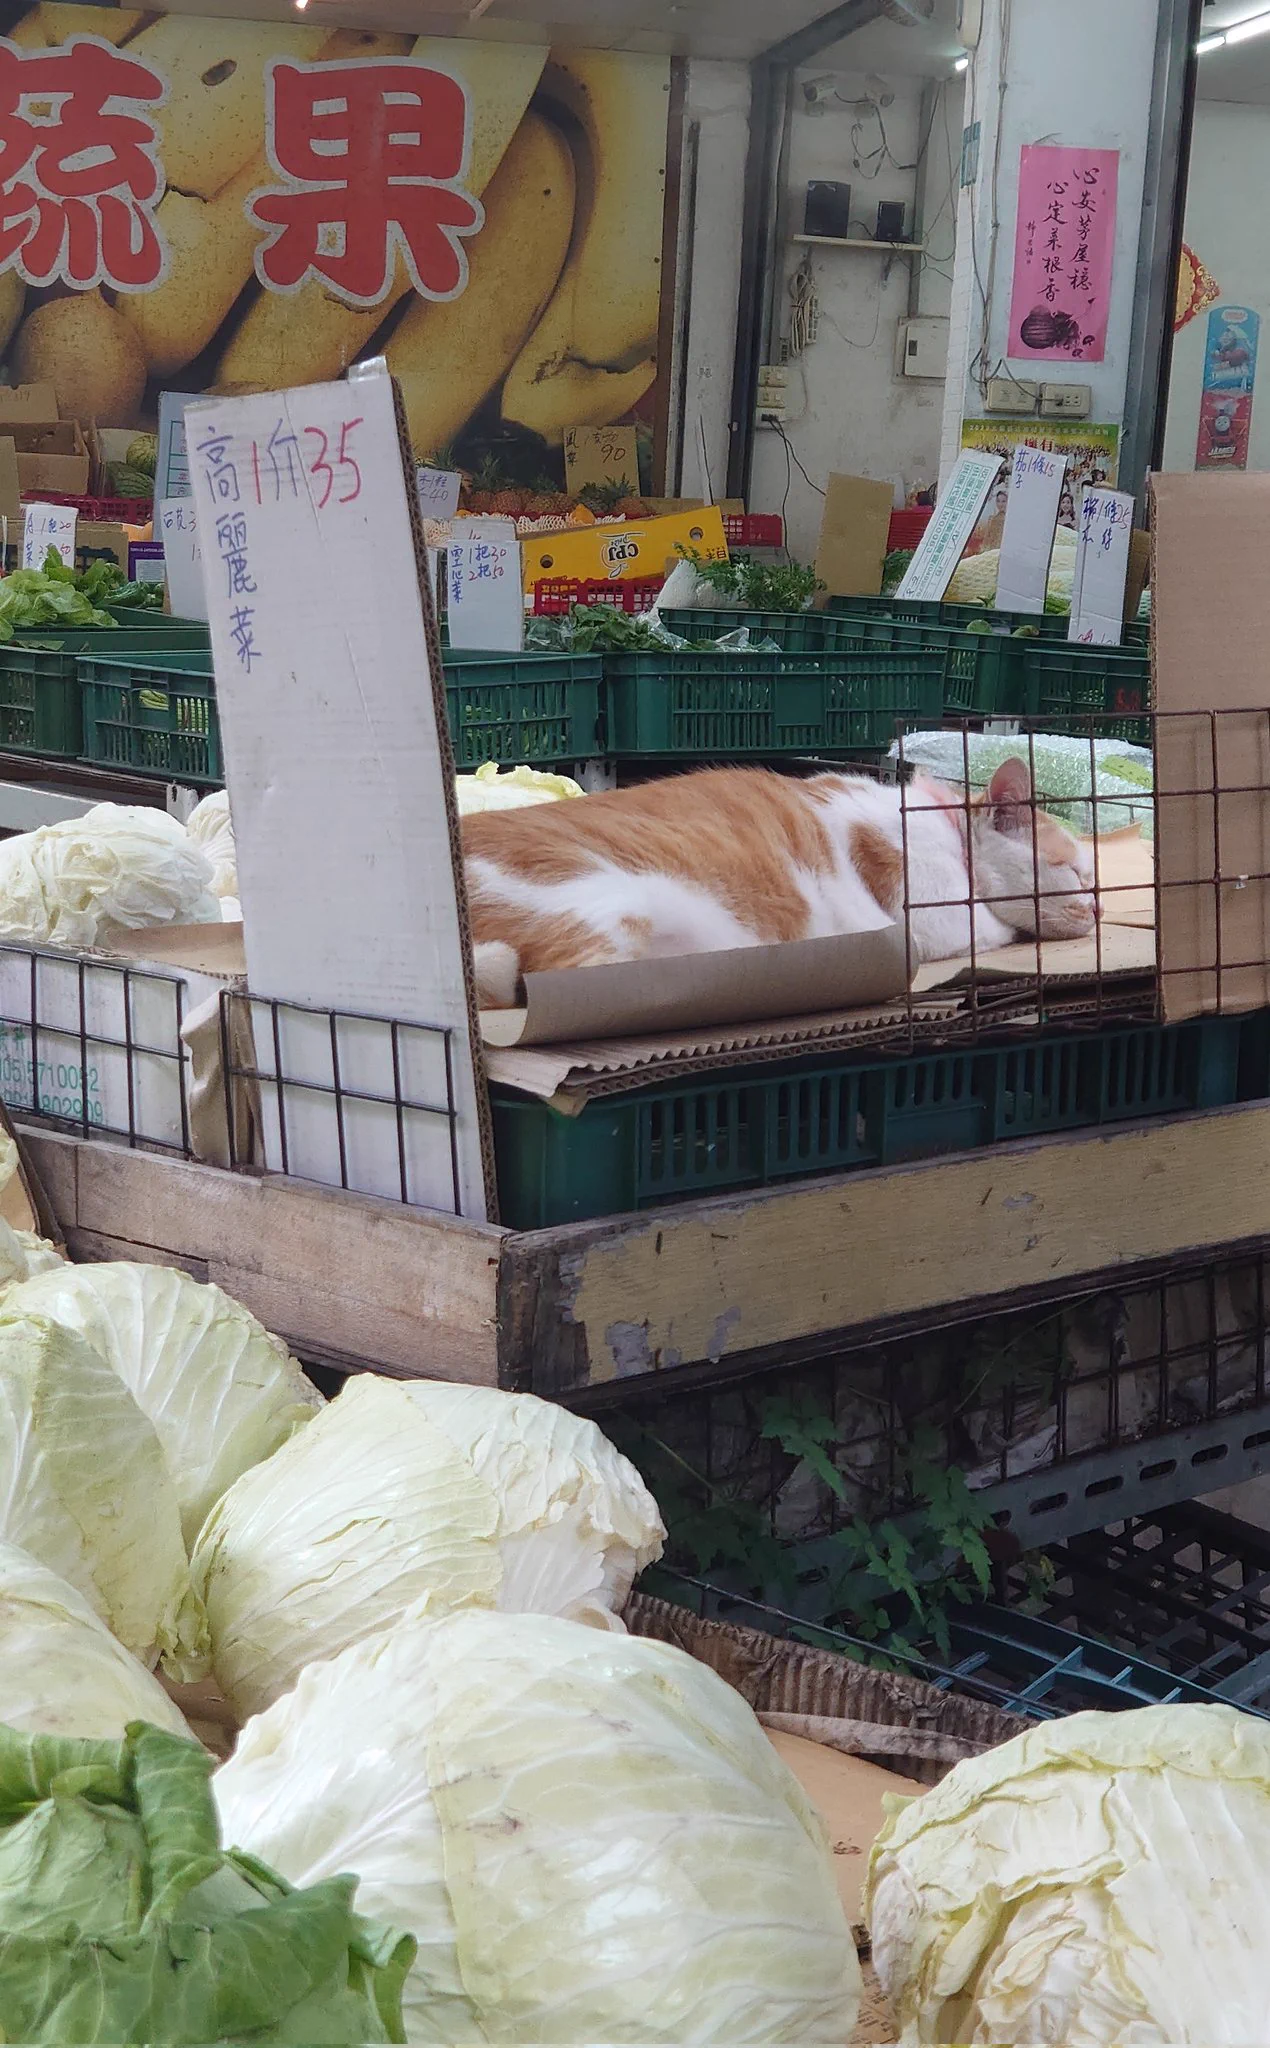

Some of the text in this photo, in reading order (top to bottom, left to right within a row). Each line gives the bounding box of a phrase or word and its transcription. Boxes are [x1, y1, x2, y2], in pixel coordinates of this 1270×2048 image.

[0, 33, 486, 306] 蔬果
[1037, 181, 1069, 302] 心定菜根香
[1066, 167, 1100, 291] 心安茅屋穩
[601, 444, 626, 464] 90
[197, 427, 261, 673] 高麗菜
[468, 563, 505, 581] 2把50
[469, 544, 507, 564] 1把30
[608, 543, 639, 562] CPJ
